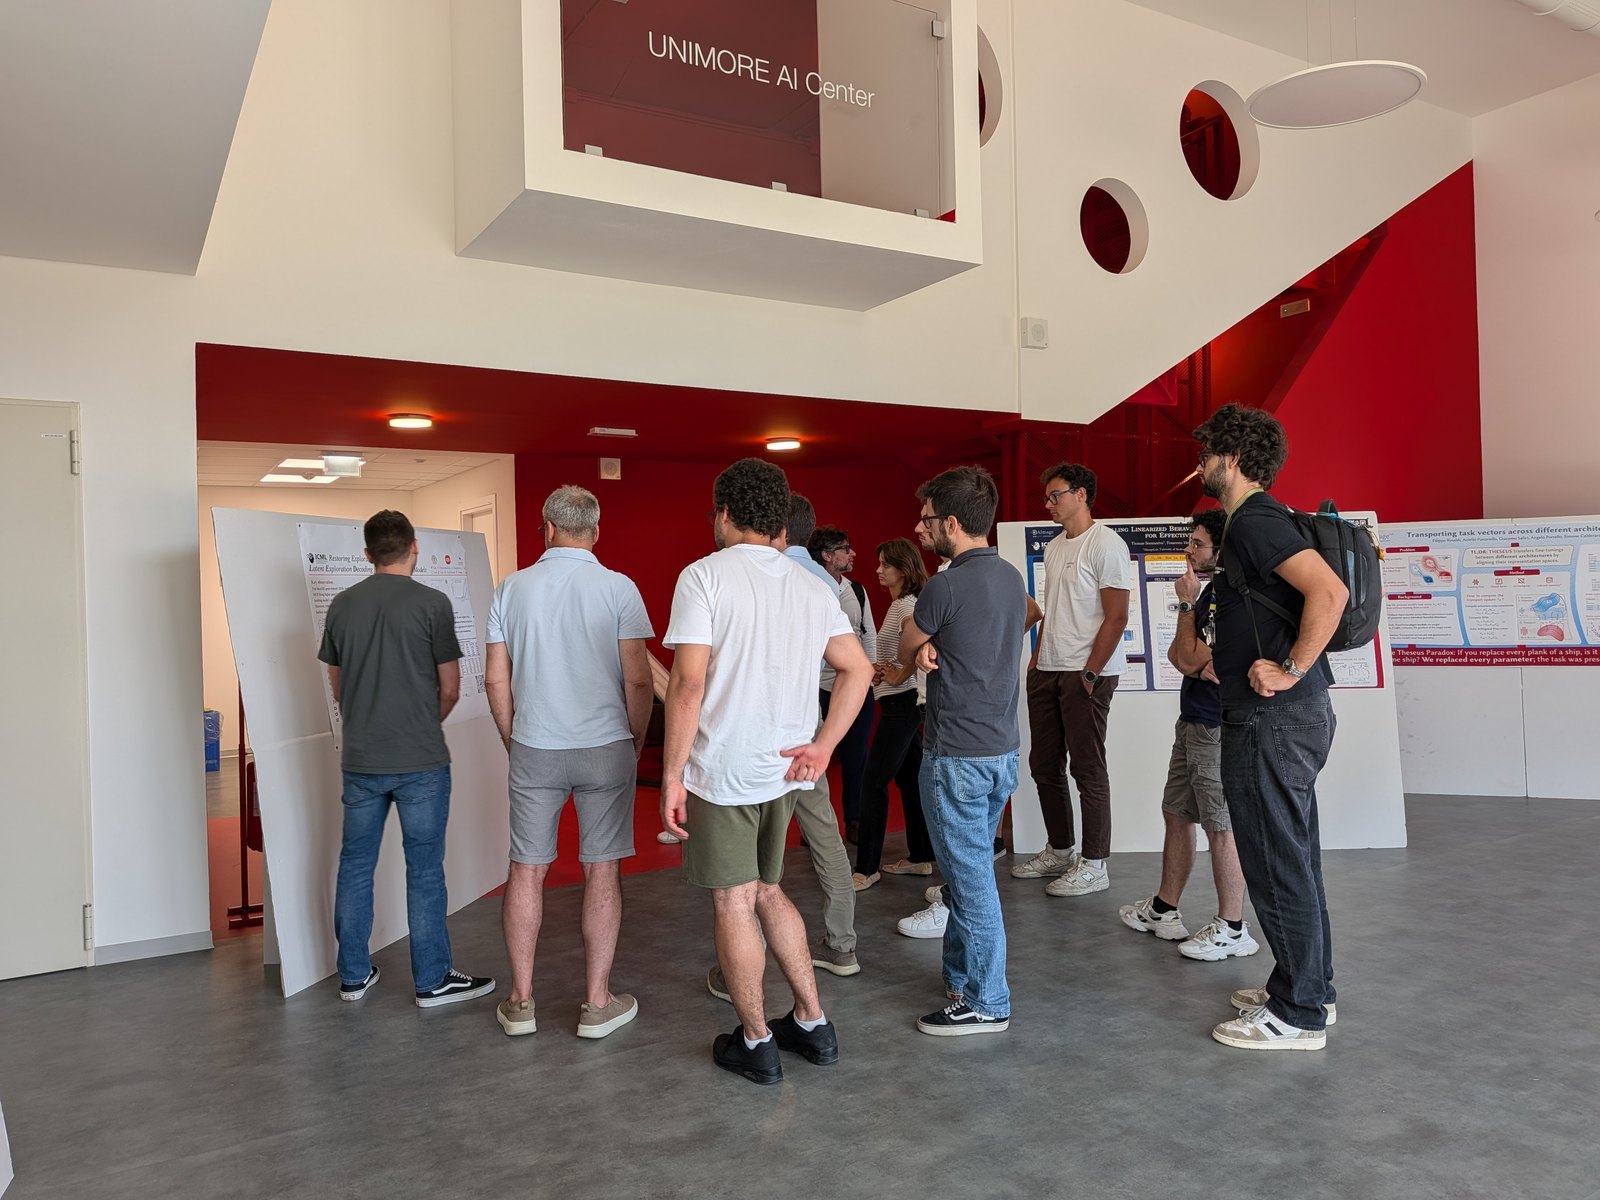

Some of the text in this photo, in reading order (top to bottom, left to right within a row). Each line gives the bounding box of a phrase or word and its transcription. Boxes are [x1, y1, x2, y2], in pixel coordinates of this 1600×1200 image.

[648, 31, 875, 108] UNIMORE AI Center
[1407, 531, 1457, 539] Transporting
[1535, 526, 1571, 534] different
[328, 554, 351, 563] Restoring
[309, 564, 374, 574] Latent Exploration Decoding
[1479, 648, 1505, 657] replace
[1527, 648, 1548, 657] plank
[1564, 648, 1583, 657] ship,
[1402, 656, 1420, 664] ship?
[1436, 655, 1467, 664] replaced
[1492, 656, 1536, 664] parameter;
